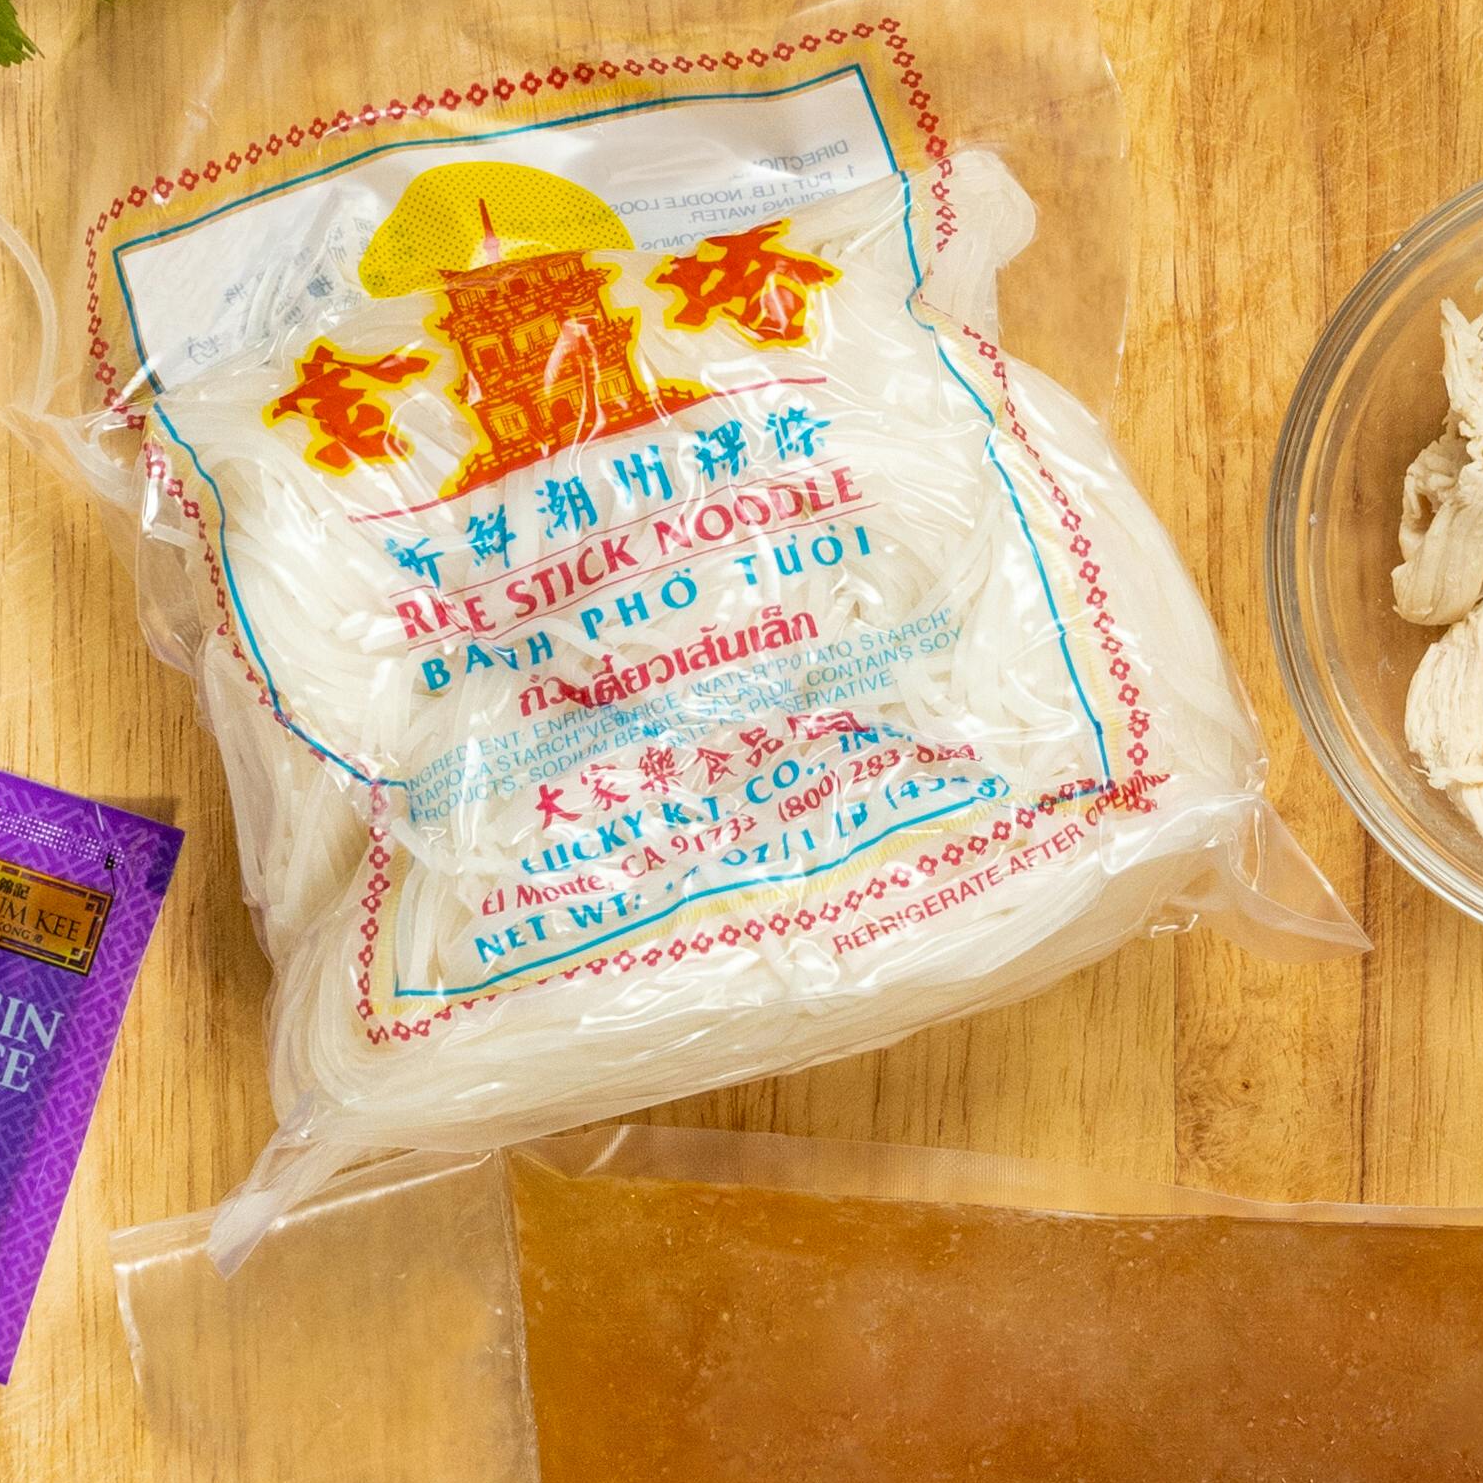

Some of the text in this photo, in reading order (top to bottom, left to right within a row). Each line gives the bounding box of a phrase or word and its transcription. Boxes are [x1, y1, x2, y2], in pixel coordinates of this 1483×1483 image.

[504, 466, 865, 619] STICK NOODLE
[806, 626, 962, 688] CONTAINS SOY
[621, 845, 667, 879] CA
[778, 769, 842, 823] (800)
[33, 908, 83, 943] KEE
[833, 822, 1086, 955] REFRIGERATE AFTER
[474, 914, 546, 964] NET
